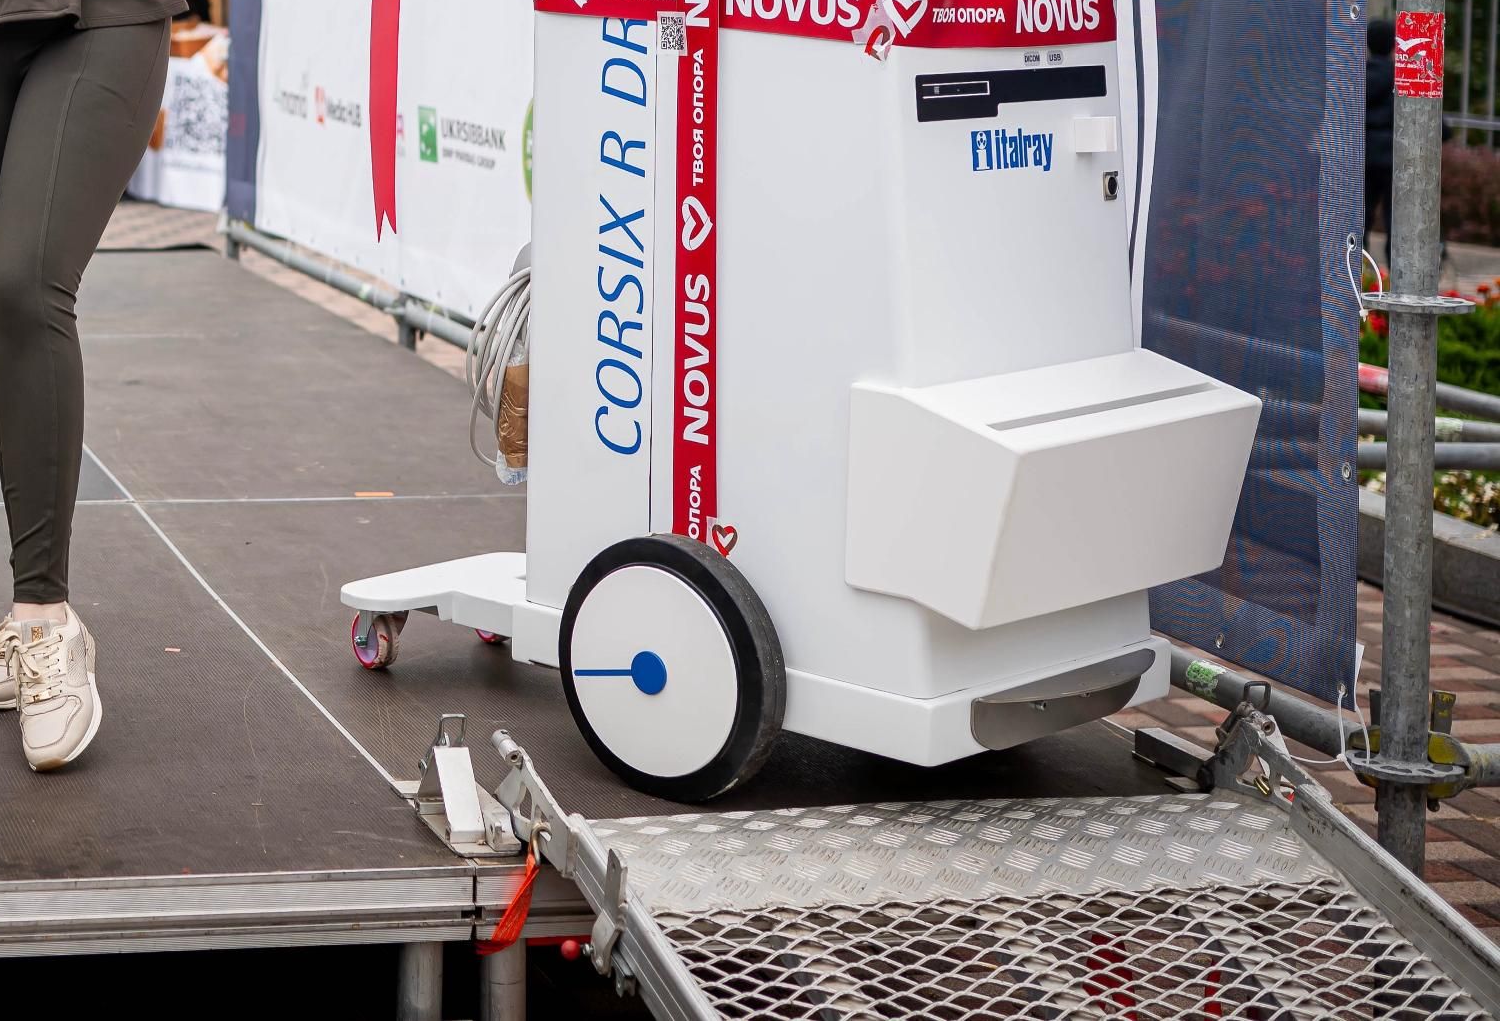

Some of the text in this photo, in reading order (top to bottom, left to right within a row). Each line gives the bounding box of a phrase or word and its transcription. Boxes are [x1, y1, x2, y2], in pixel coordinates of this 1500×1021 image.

[932, 8, 955, 23] ТВОЯ
[957, 7, 1006, 23] ОПОРА
[1024, 53, 1041, 63] DICOM
[1048, 53, 1062, 62] USB
[692, 48, 704, 186] ТВОЯ ОПОРА
[600, 130, 646, 178] R
[994, 128, 1053, 172] italray
[594, 193, 645, 455] CORSIX
[682, 274, 711, 445] NOVUS
[688, 464, 702, 540] ОПОРА
